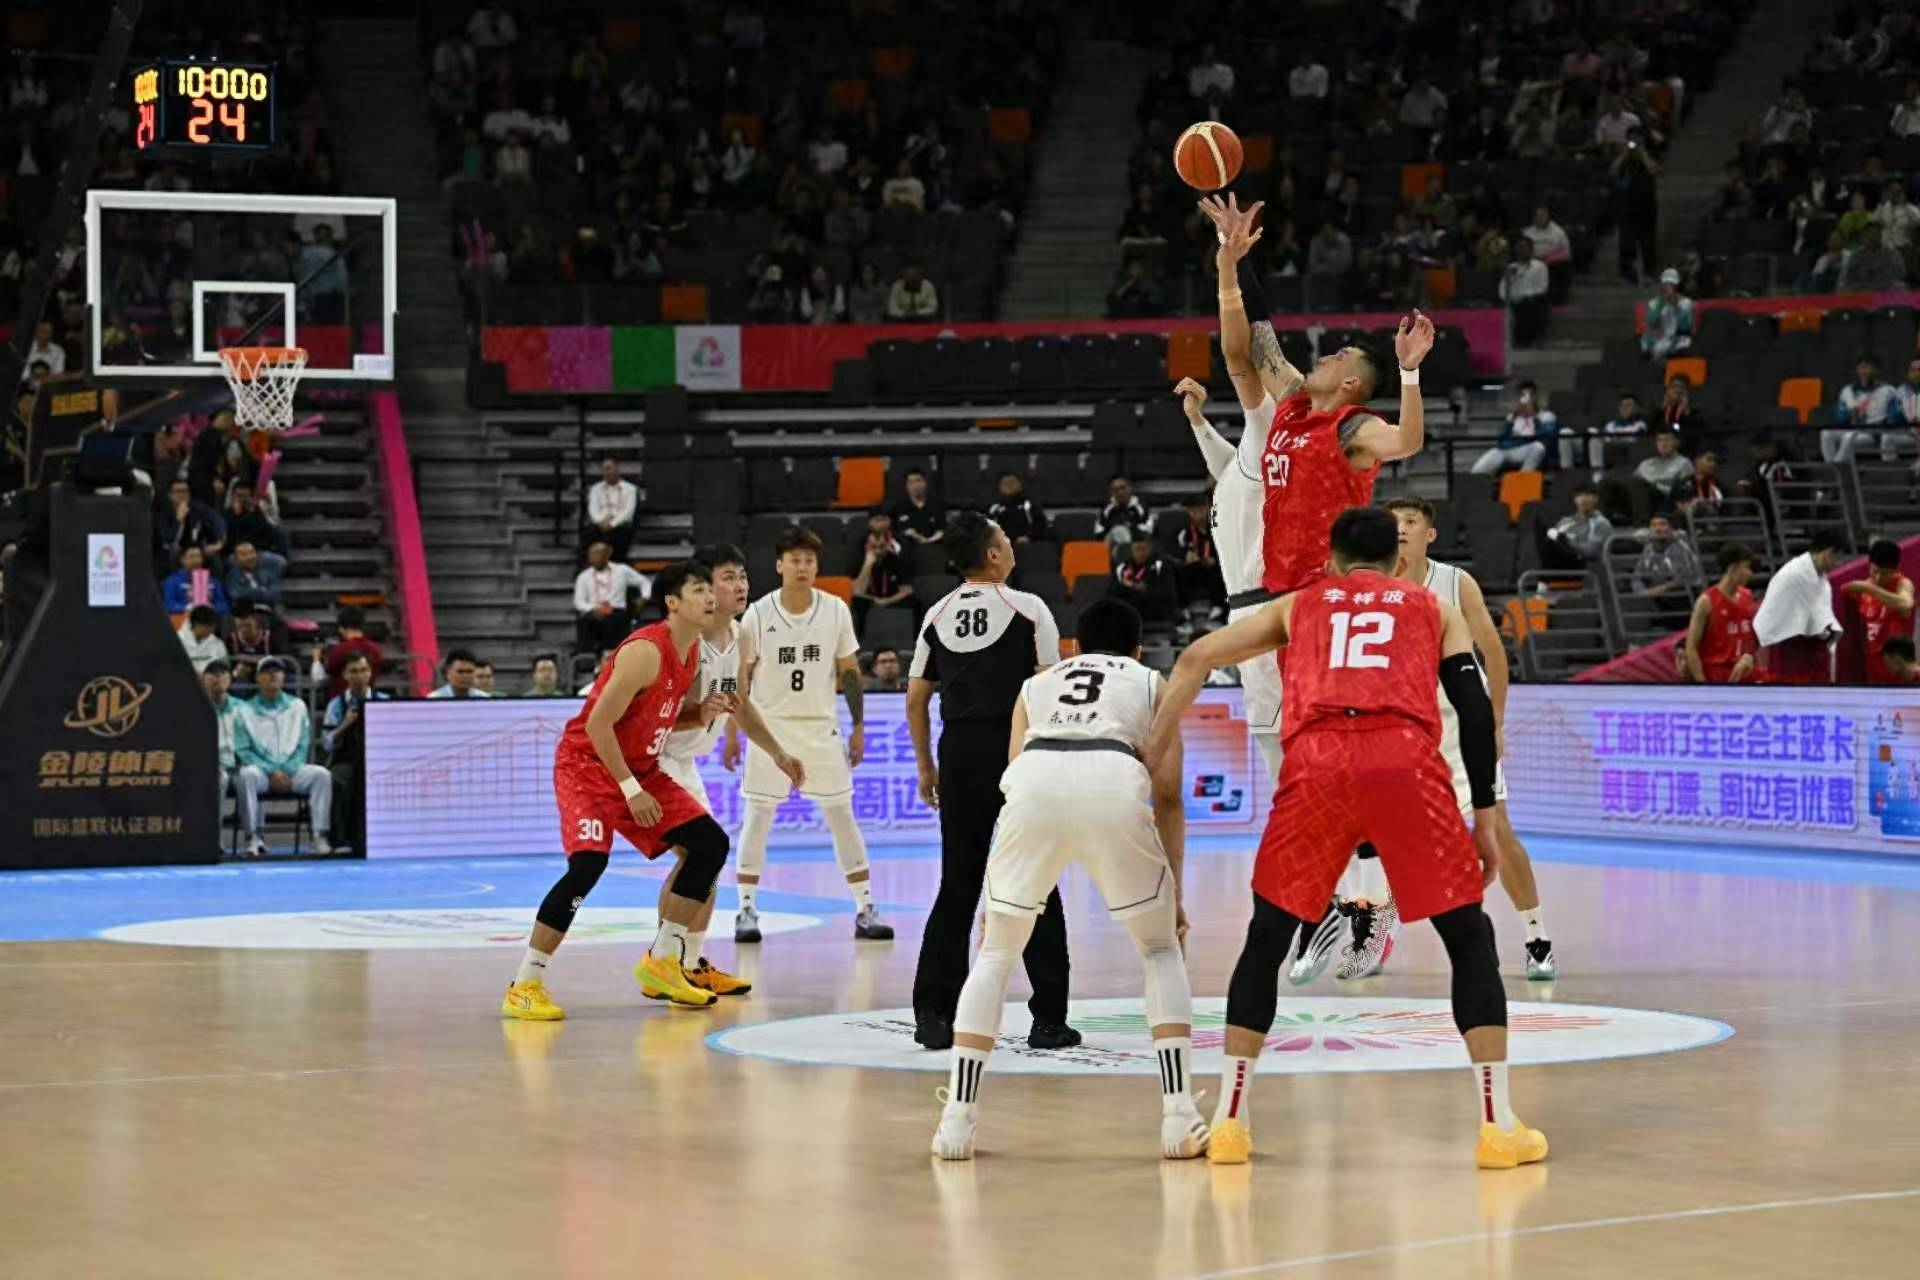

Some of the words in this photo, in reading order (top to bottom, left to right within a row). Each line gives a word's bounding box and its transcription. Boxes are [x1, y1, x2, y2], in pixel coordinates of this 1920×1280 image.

[188, 98, 245, 144] 24
[1264, 453, 1290, 487] 20
[956, 608, 988, 638] 38
[778, 644, 820, 664] 廣東
[1329, 611, 1395, 669] 12
[791, 669, 805, 692] 8
[1058, 669, 1106, 706] 3
[1593, 711, 1854, 763] 工商银行全运会主题卡
[106, 775, 172, 787] SPORTS
[578, 818, 604, 842] 30
